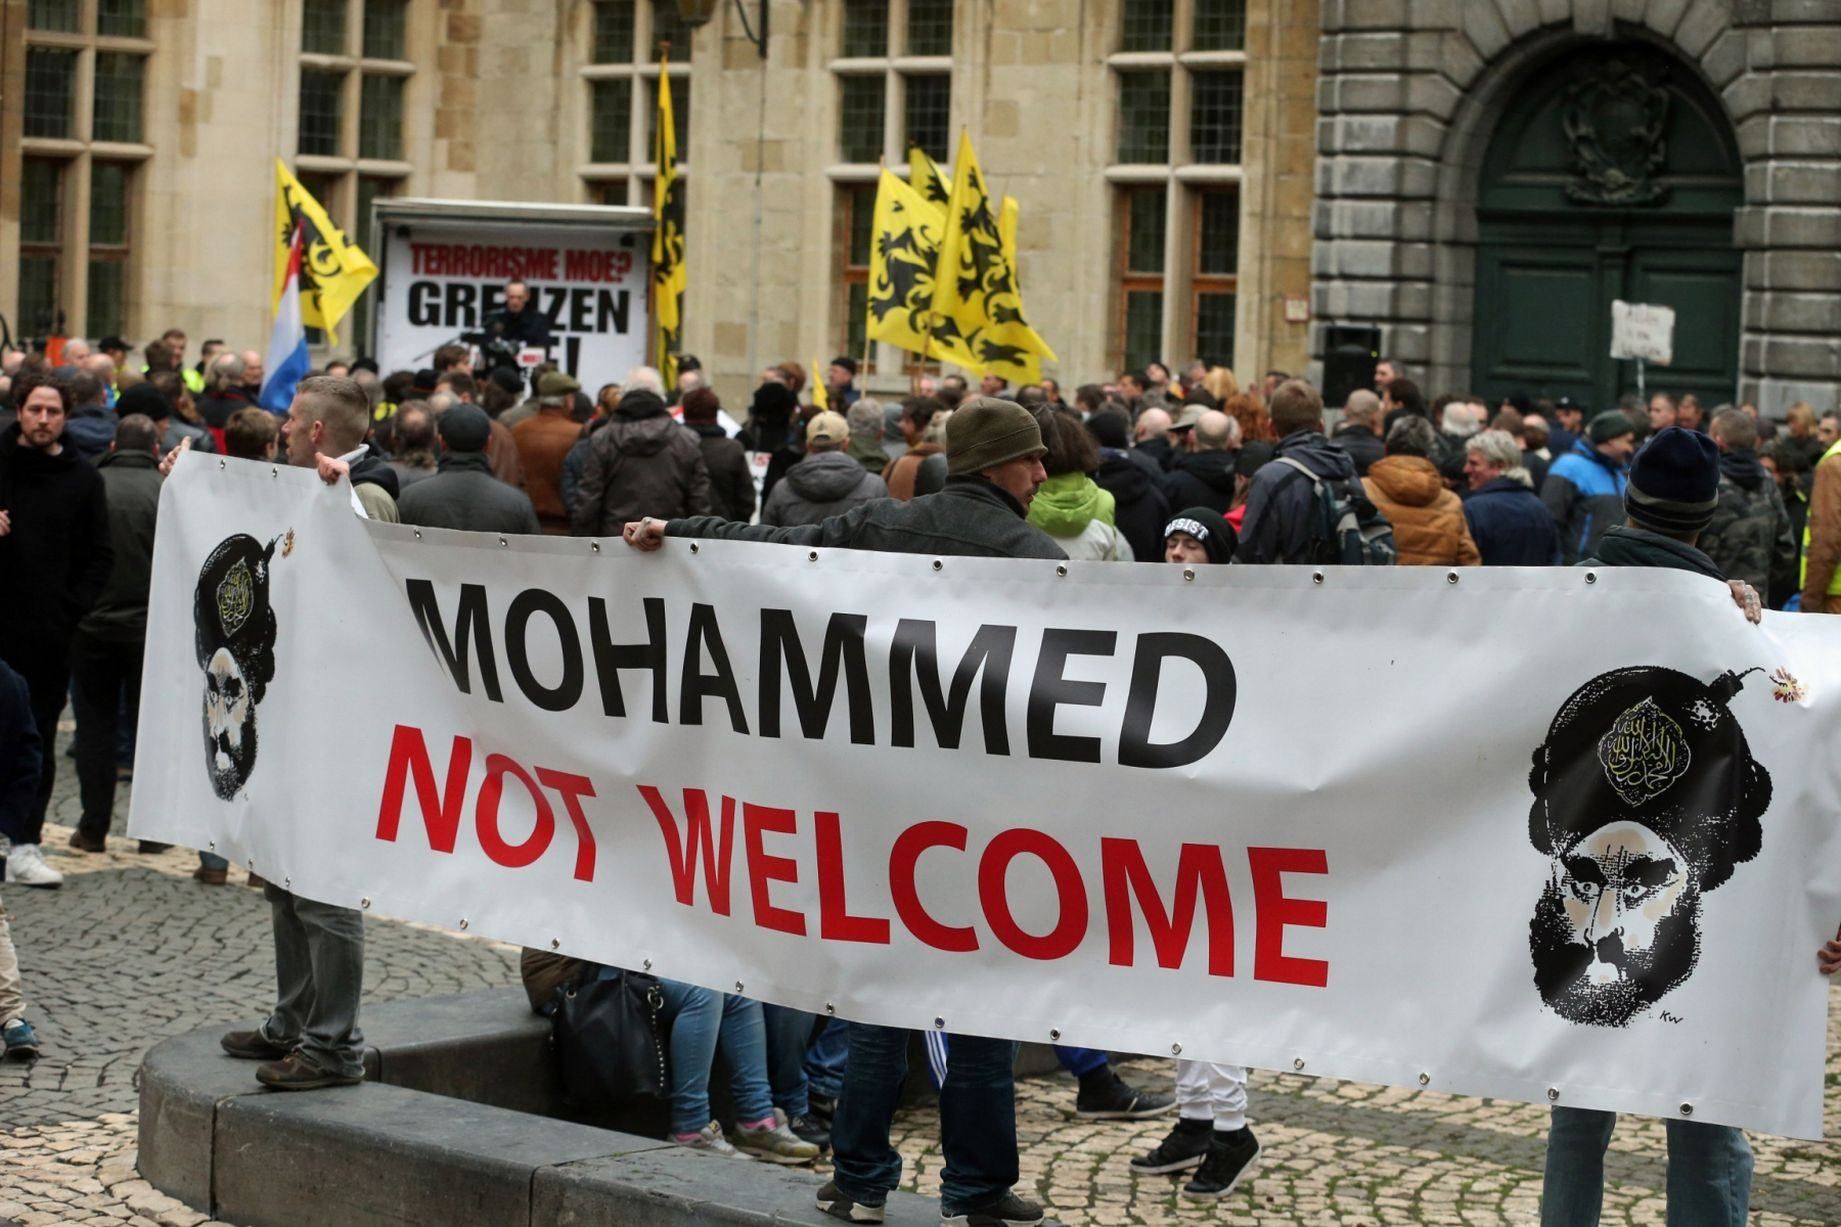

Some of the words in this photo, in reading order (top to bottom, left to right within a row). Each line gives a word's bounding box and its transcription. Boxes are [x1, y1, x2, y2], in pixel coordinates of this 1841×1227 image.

[411, 244, 558, 279] TERRORISME
[565, 251, 632, 283] MOE?
[406, 579, 1236, 768] MOHAMMED
[376, 725, 597, 883] NOT
[636, 784, 1328, 988] WELCOME
